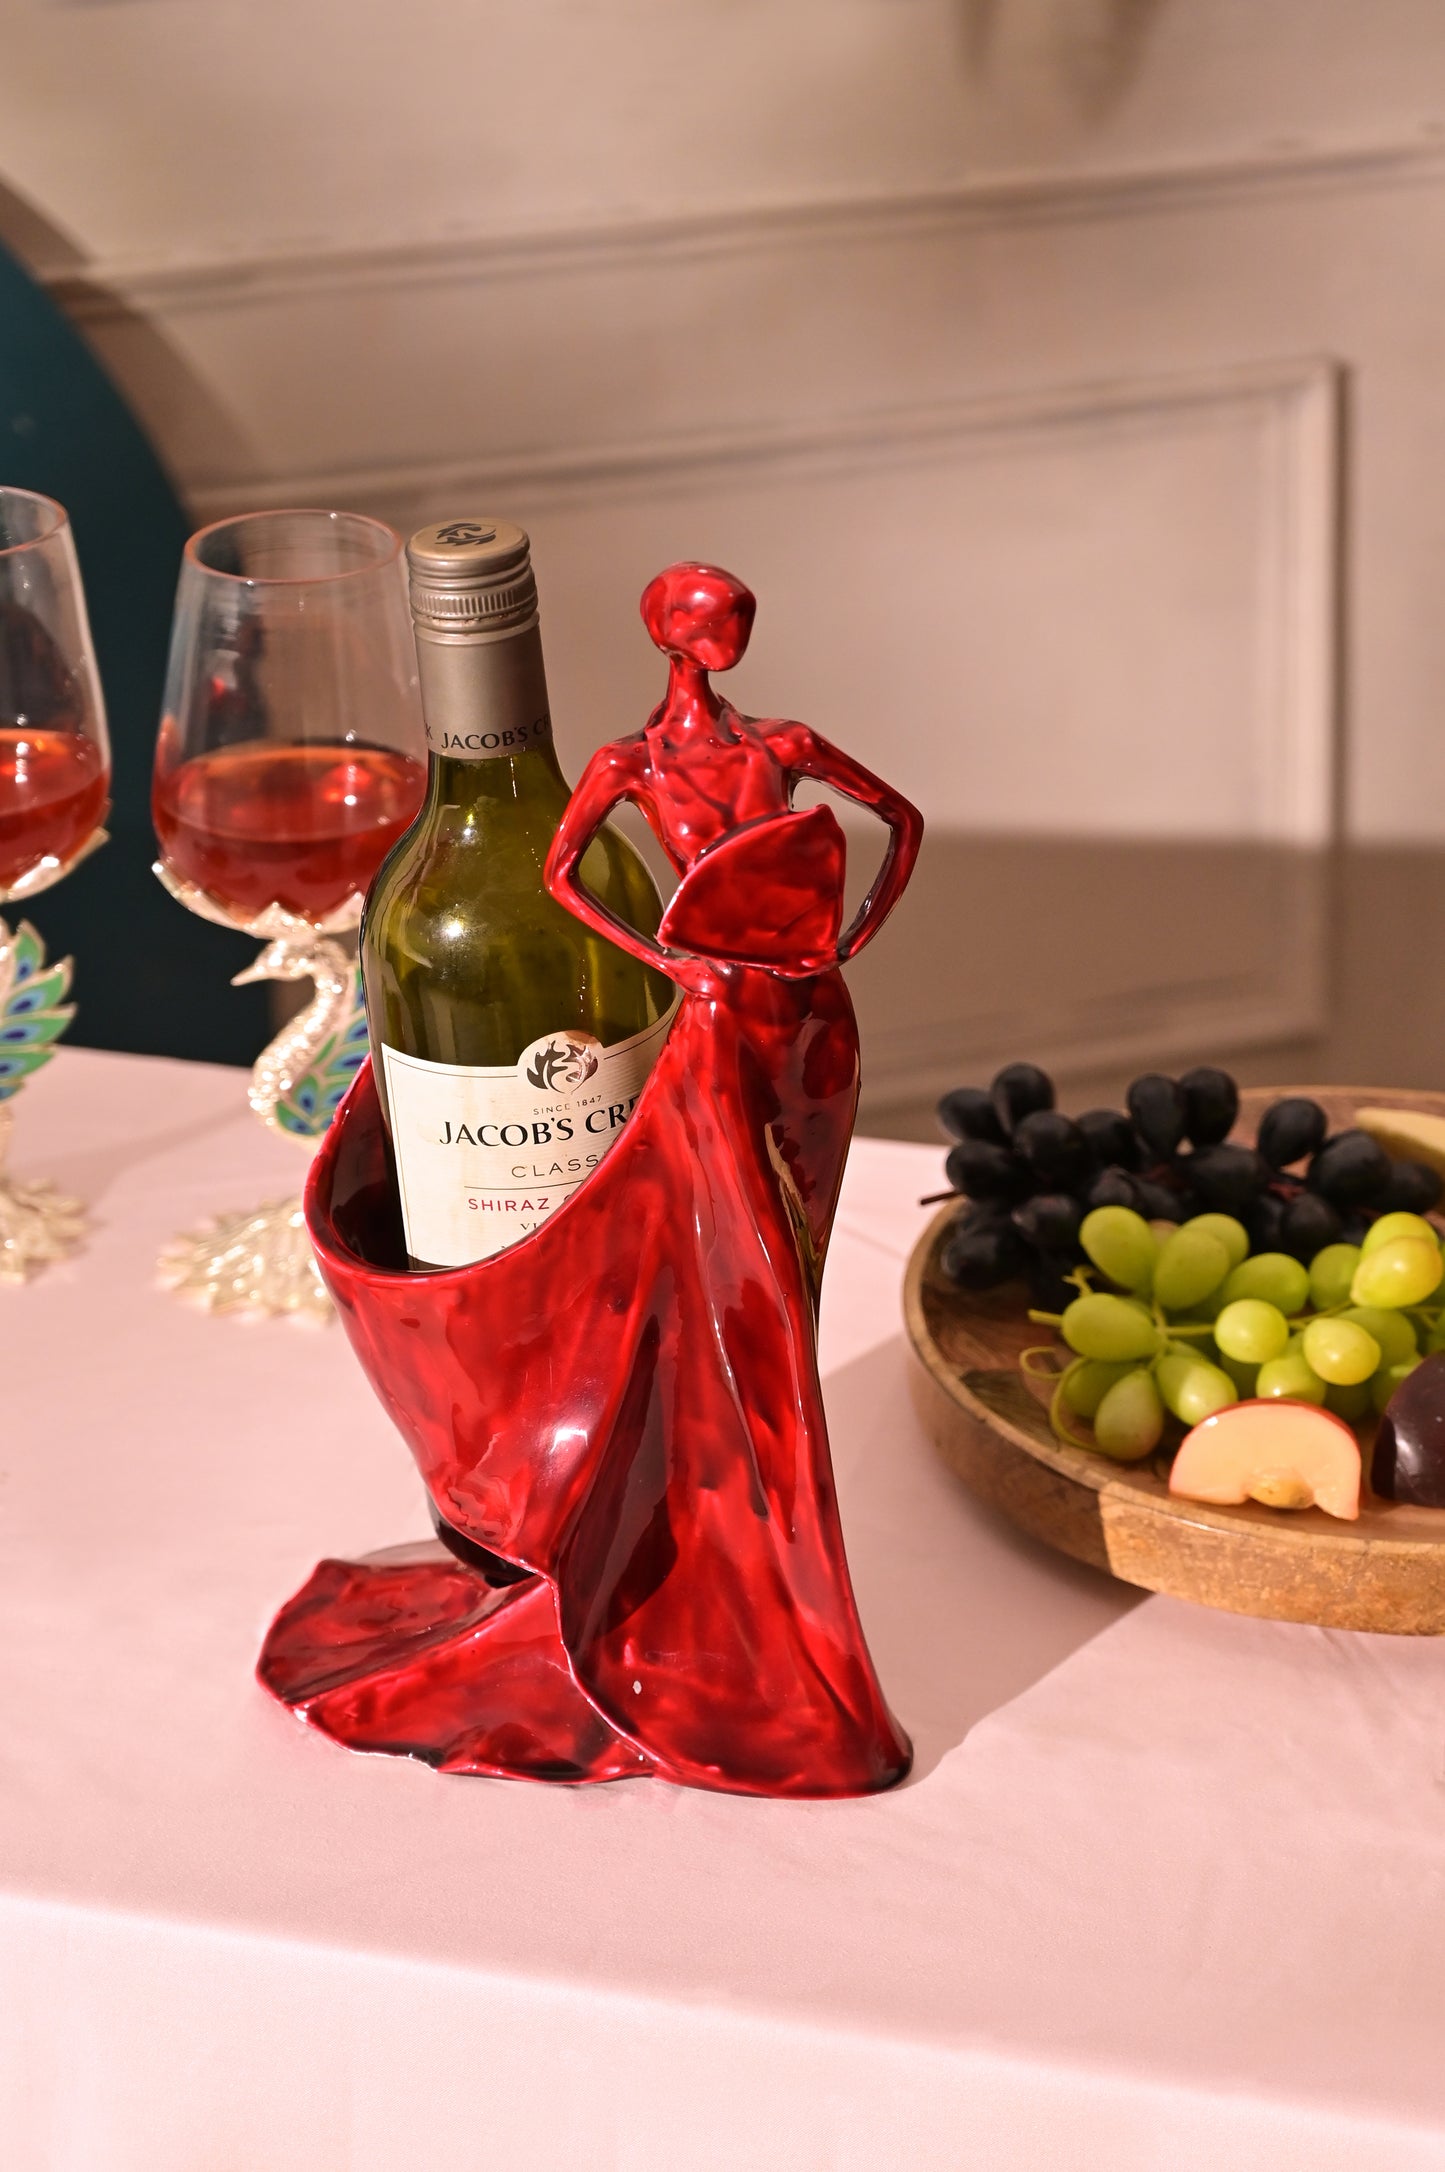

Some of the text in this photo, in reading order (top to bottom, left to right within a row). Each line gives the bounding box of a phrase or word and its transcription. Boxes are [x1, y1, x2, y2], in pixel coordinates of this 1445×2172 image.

[441, 726, 528, 750] JACOB'S
[533, 1094, 602, 1115] SINCE 1847
[439, 1117, 574, 1147] JACOB'S
[511, 1152, 605, 1178] CLASS
[468, 1197, 550, 1212] SHIRAZ
